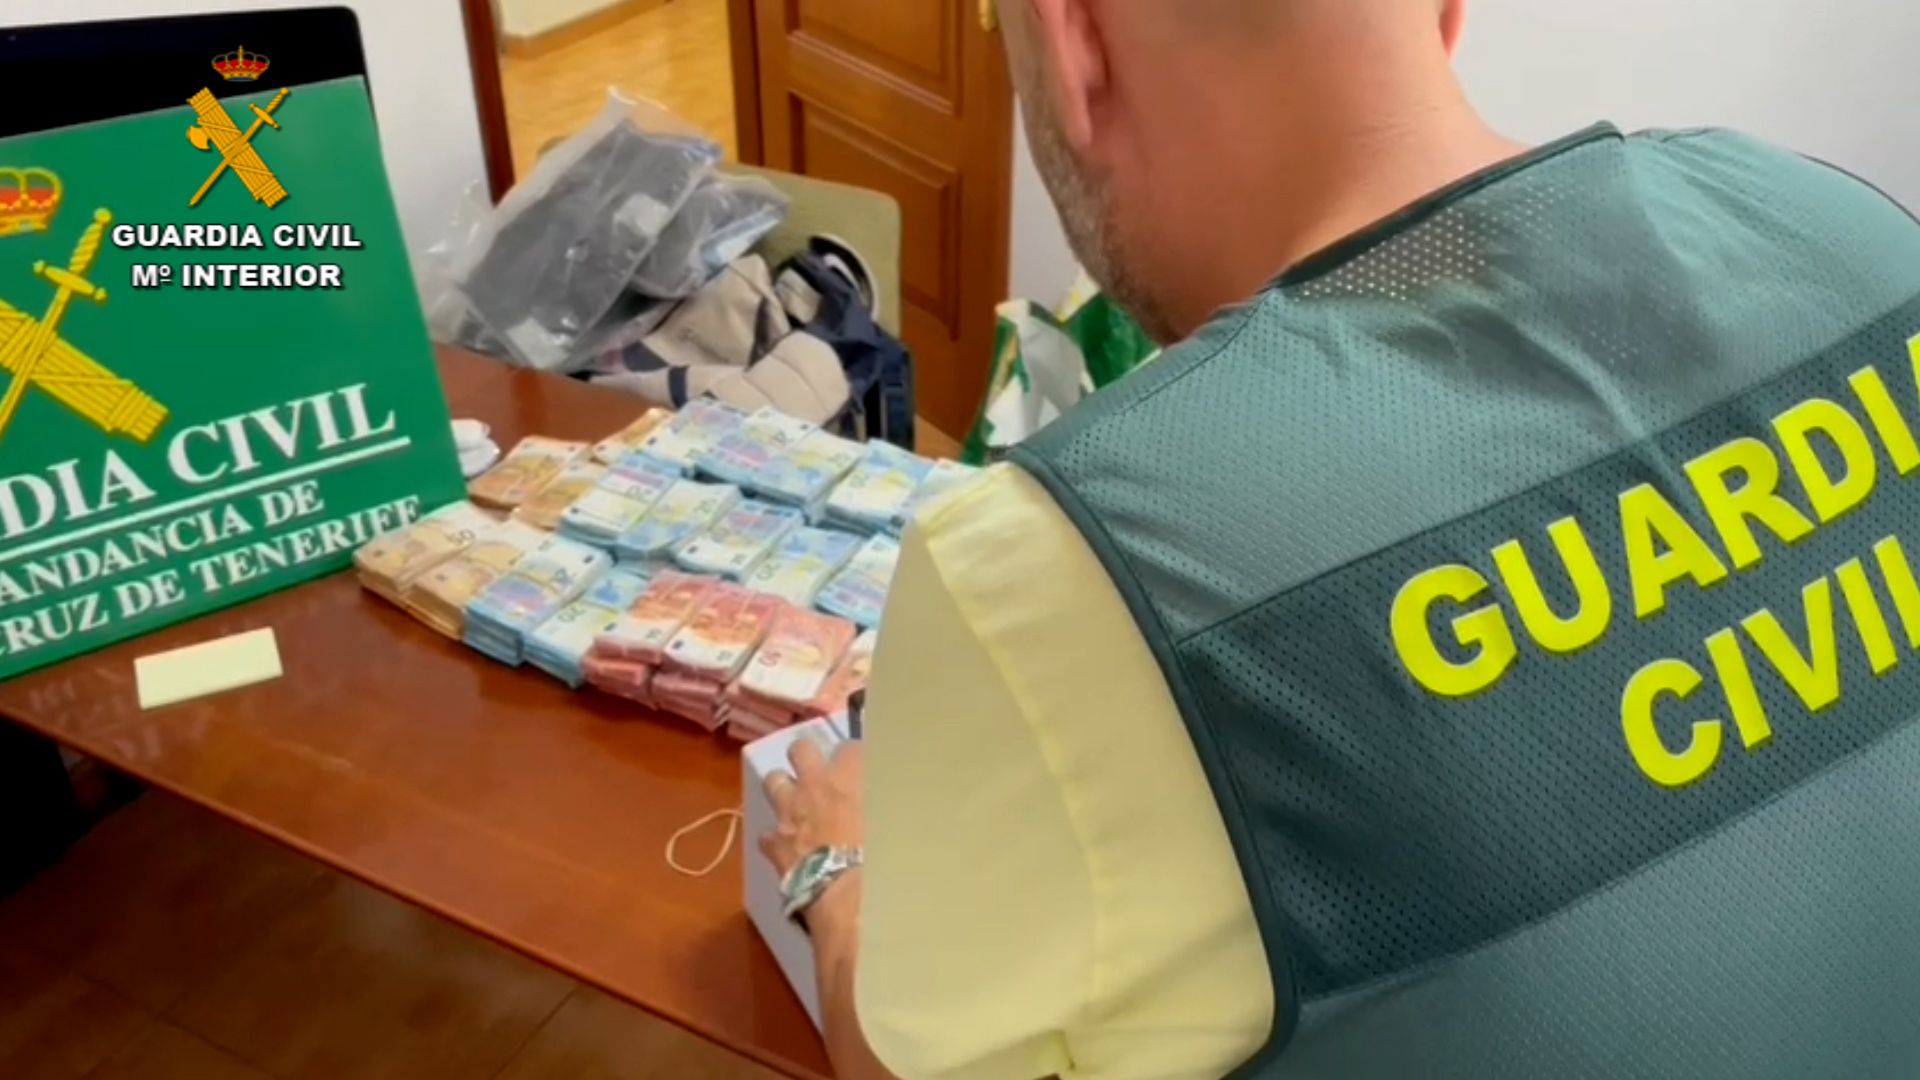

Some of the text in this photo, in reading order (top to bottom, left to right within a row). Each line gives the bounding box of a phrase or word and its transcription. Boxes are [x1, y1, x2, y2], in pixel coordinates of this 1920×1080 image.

[167, 383, 396, 483] CIVIL
[0, 480, 325, 607] ANDANCIA DE
[1391, 333, 1920, 696] GUARDI
[0, 592, 110, 656] RUZ
[113, 569, 186, 619] DE
